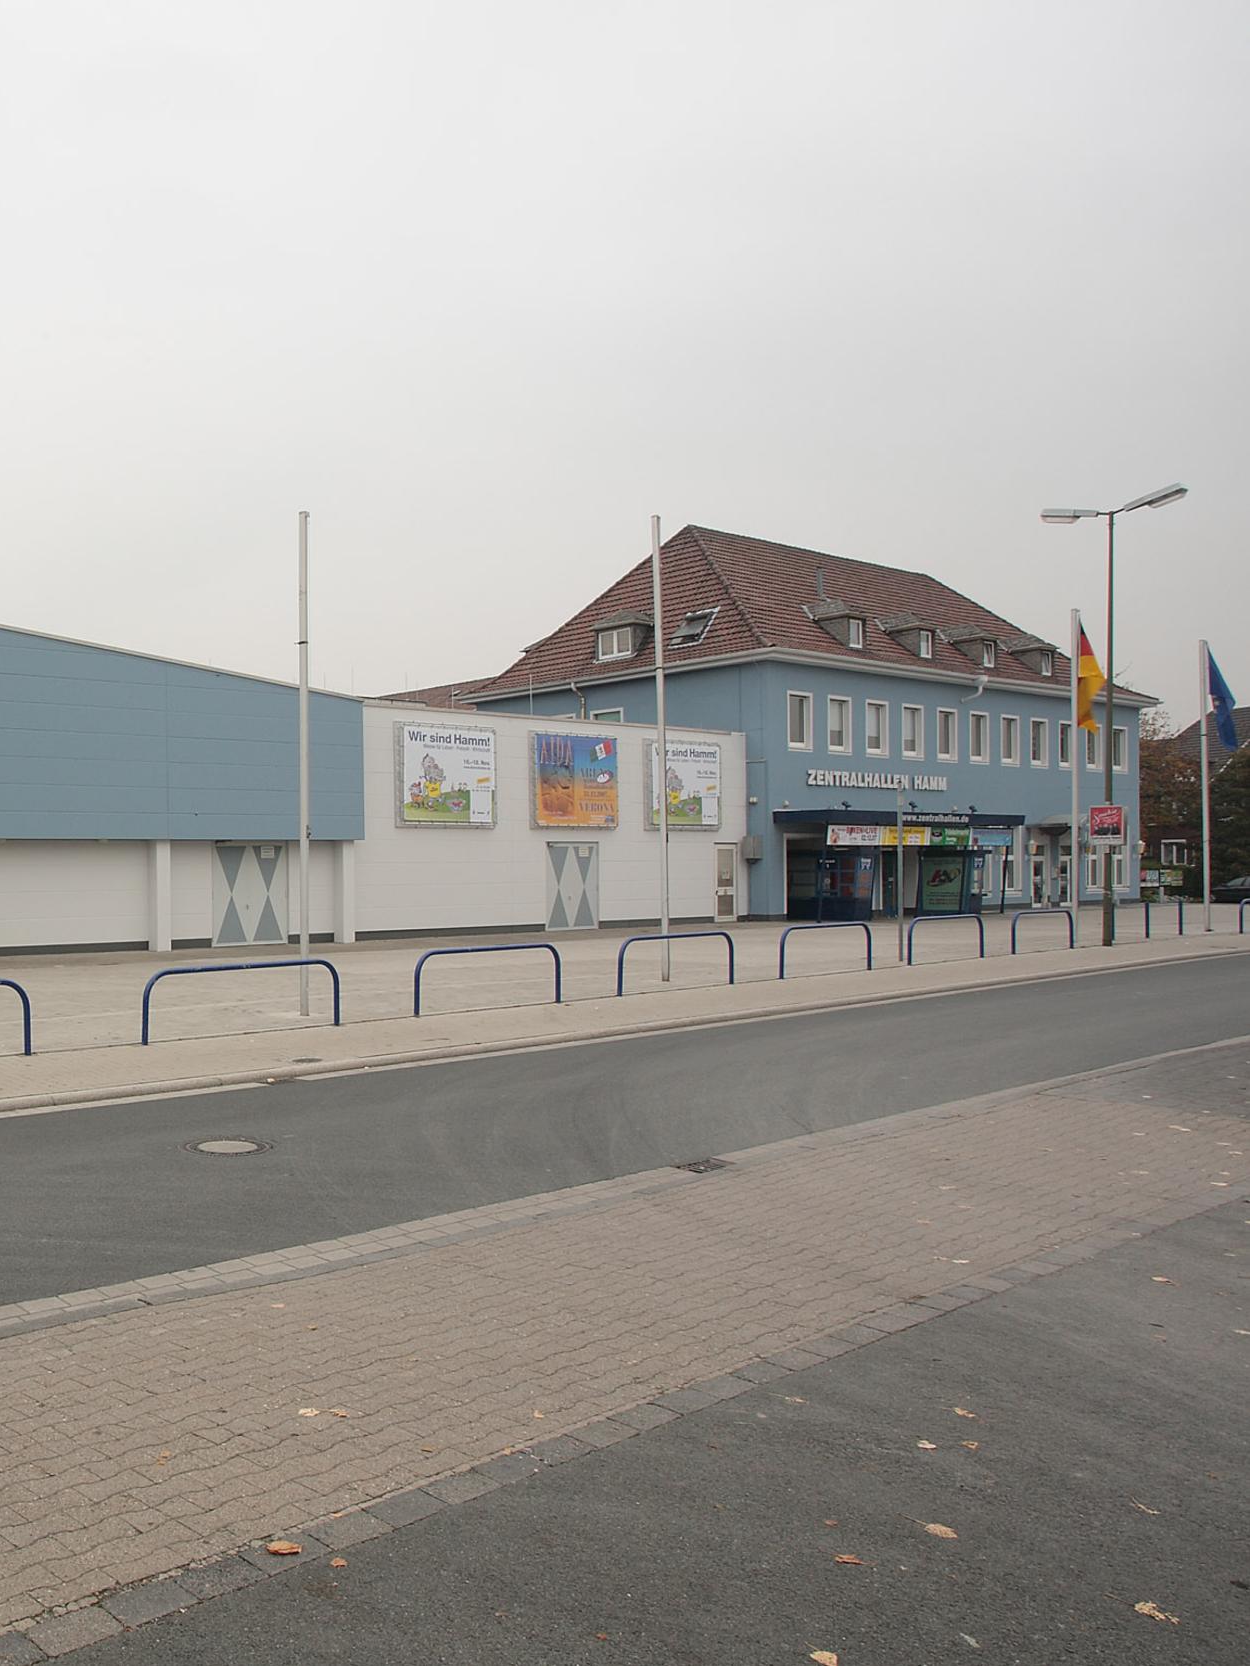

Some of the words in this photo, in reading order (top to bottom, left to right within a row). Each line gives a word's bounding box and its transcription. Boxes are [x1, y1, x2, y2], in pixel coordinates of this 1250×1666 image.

[408, 730, 427, 742] Wir
[429, 732, 452, 744] sind
[453, 733, 490, 747] Hamm!
[671, 747, 688, 758] sind
[689, 747, 717, 760] Hamm!
[807, 768, 909, 790] ZENTRALHALLEN
[913, 774, 948, 791] HAMM
